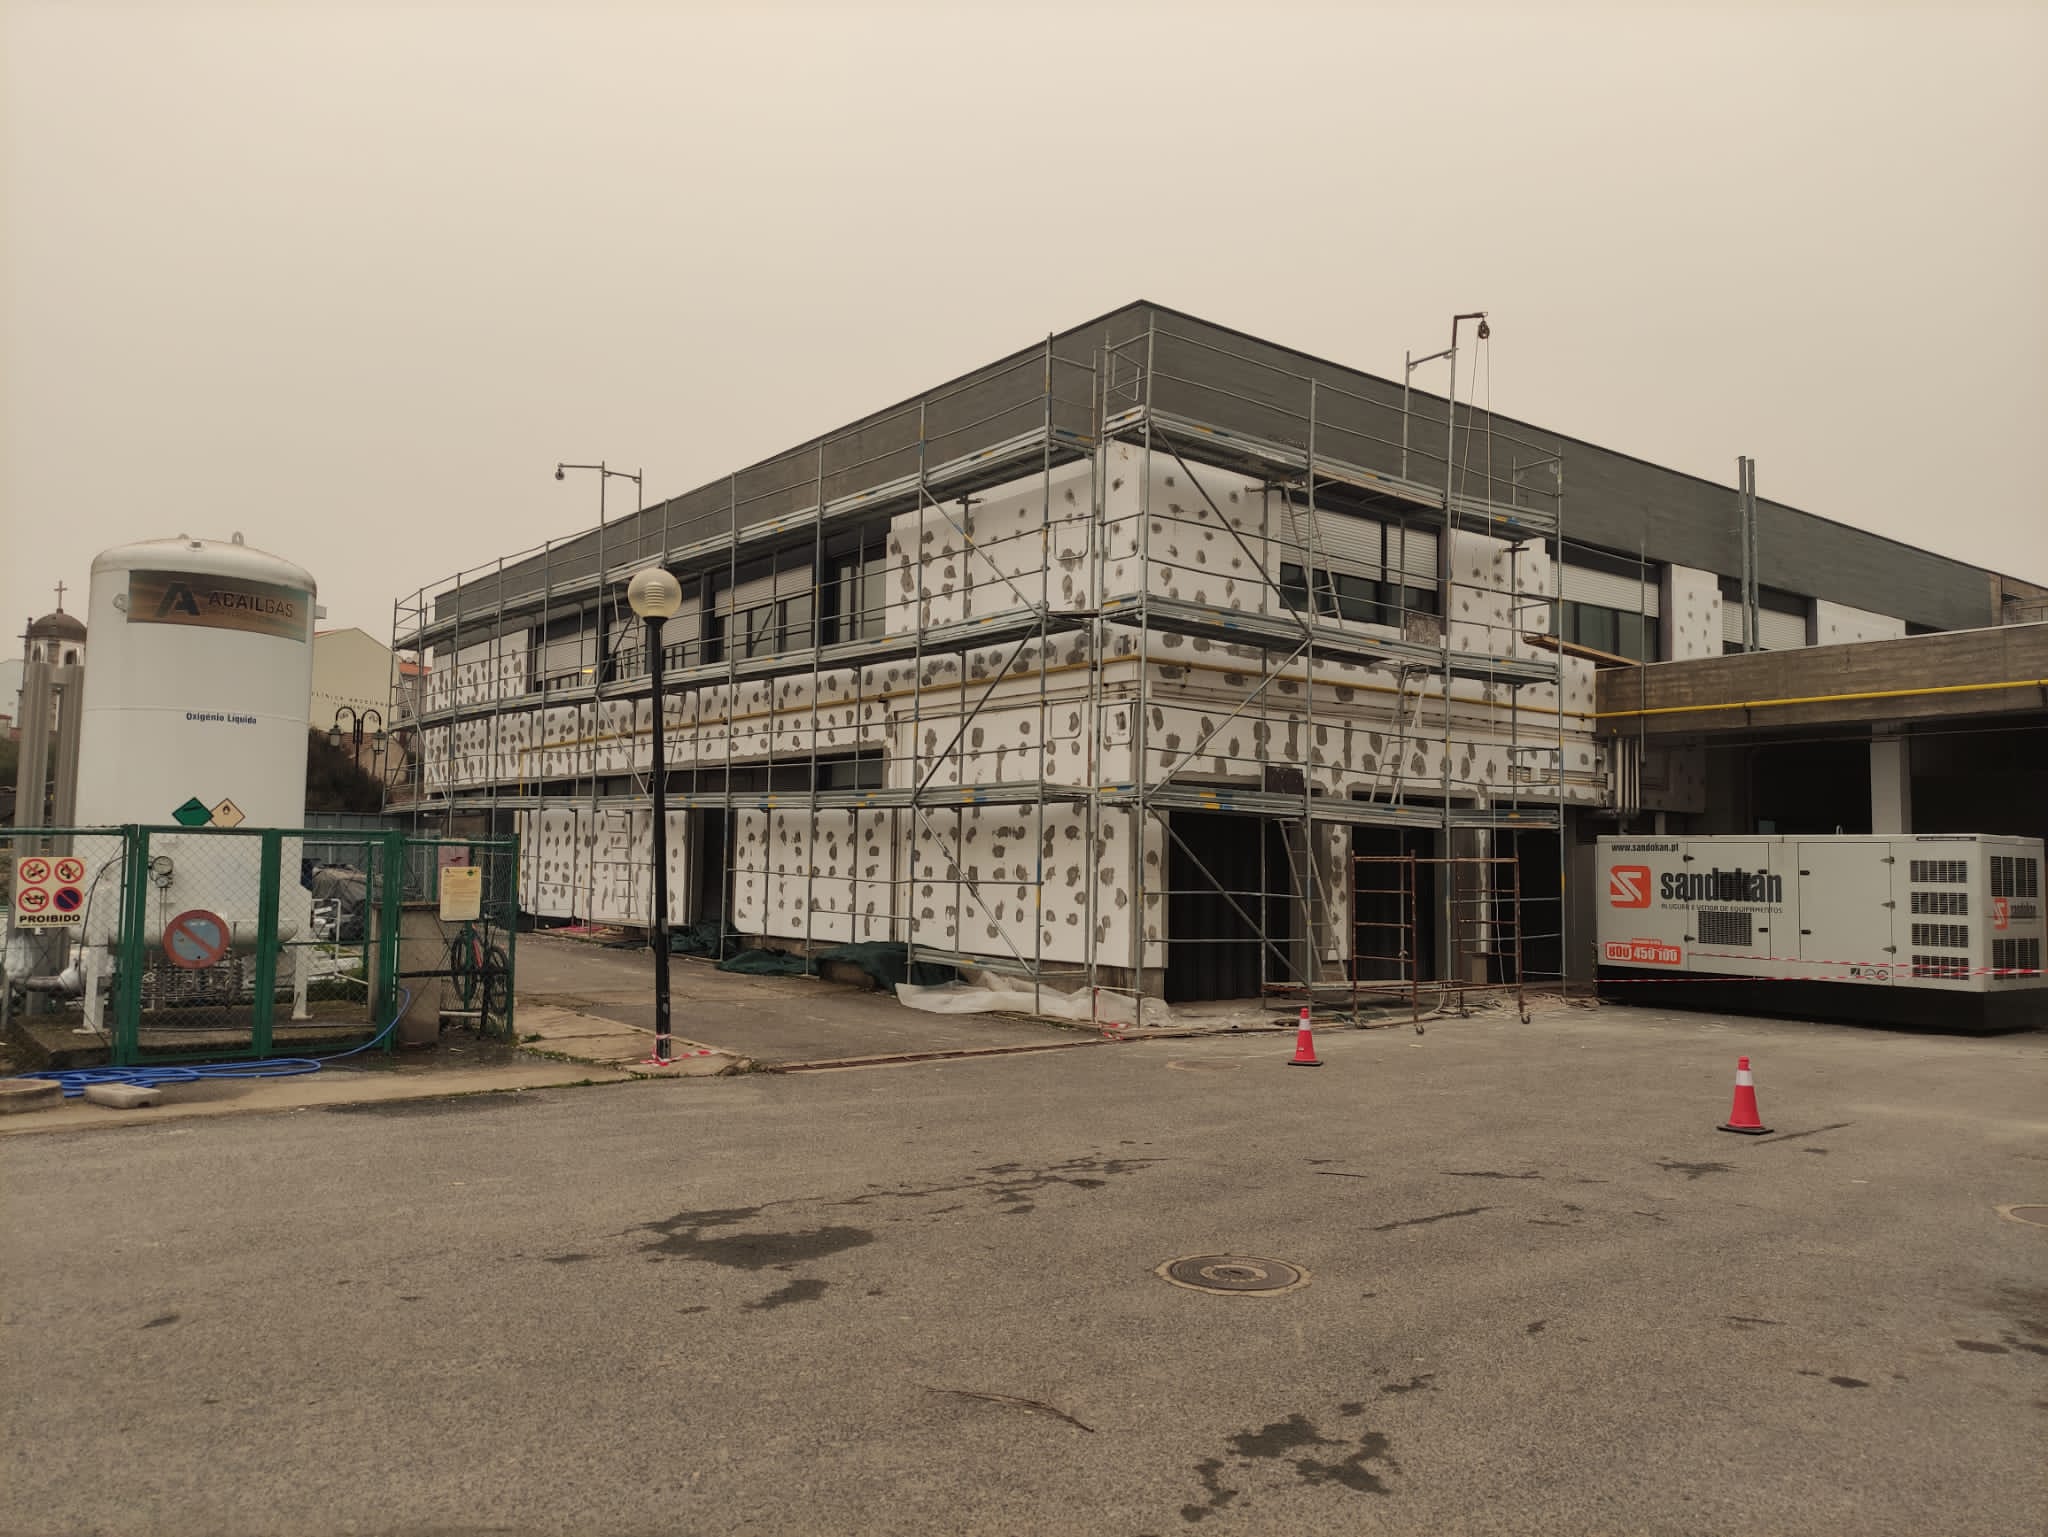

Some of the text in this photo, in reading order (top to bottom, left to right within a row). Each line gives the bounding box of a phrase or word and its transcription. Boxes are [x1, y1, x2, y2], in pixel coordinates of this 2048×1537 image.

[1611, 842, 1679, 852] www.sandokan.pt
[1660, 867, 1782, 903] sandokan
[19, 914, 81, 923] PROIBIDO
